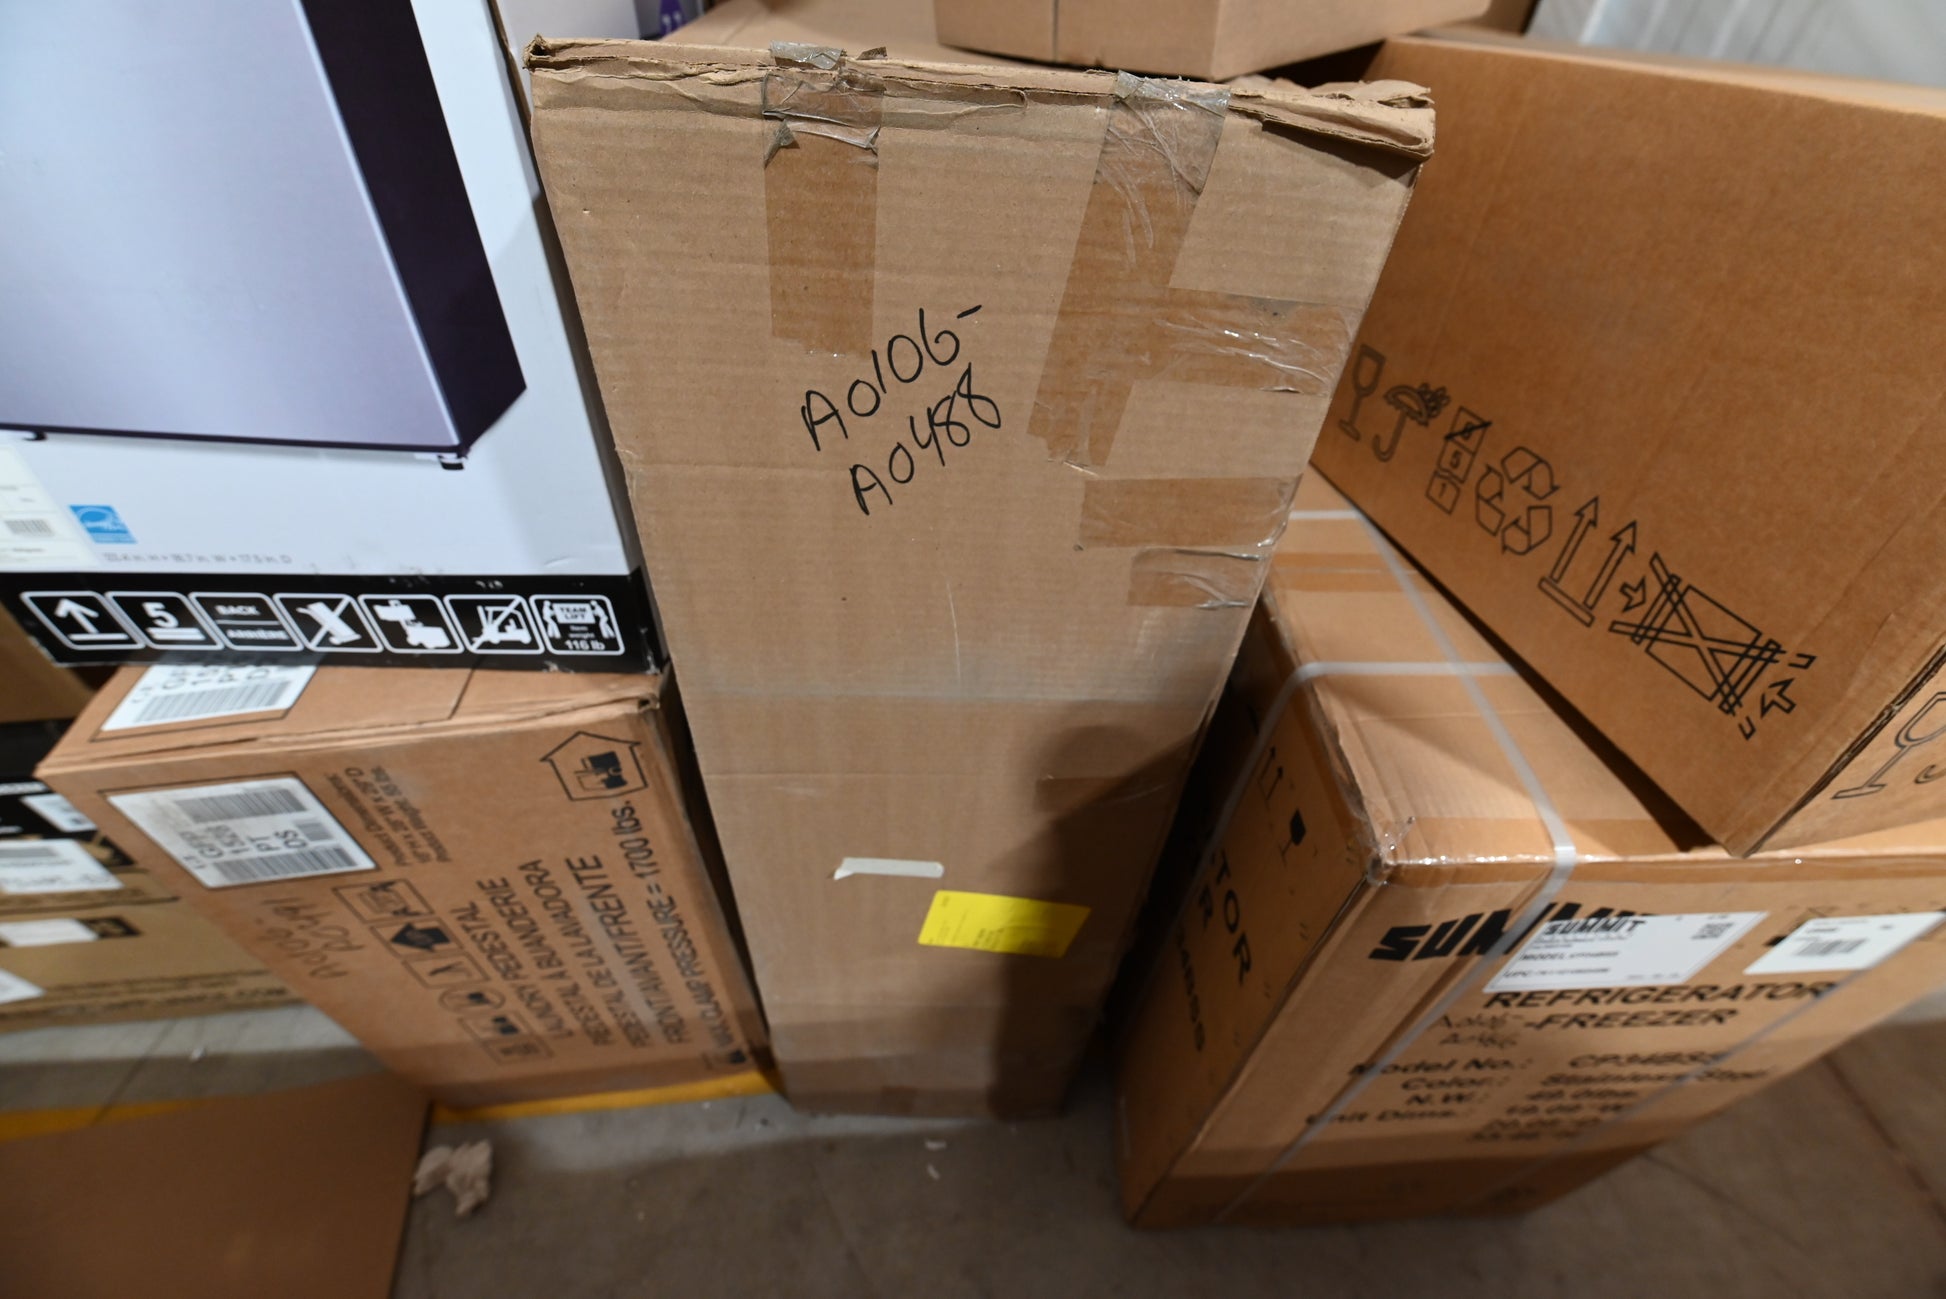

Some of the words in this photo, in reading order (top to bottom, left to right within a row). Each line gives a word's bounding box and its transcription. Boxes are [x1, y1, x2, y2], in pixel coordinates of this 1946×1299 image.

[802, 305, 982, 451] A0106-
[850, 362, 1001, 515] A0488
[142, 602, 179, 628] 5
[558, 606, 588, 614] TEAM
[564, 613, 586, 621] LIFT
[564, 639, 589, 651] 116
[611, 800, 643, 835] lbs.
[618, 837, 661, 879] 1700
[476, 877, 563, 969] BUANDERIE
[1542, 917, 1648, 937] SUMMIT
[448, 900, 529, 981] PEDESTAL
[1482, 981, 1838, 1012] REFRIGERATOR
